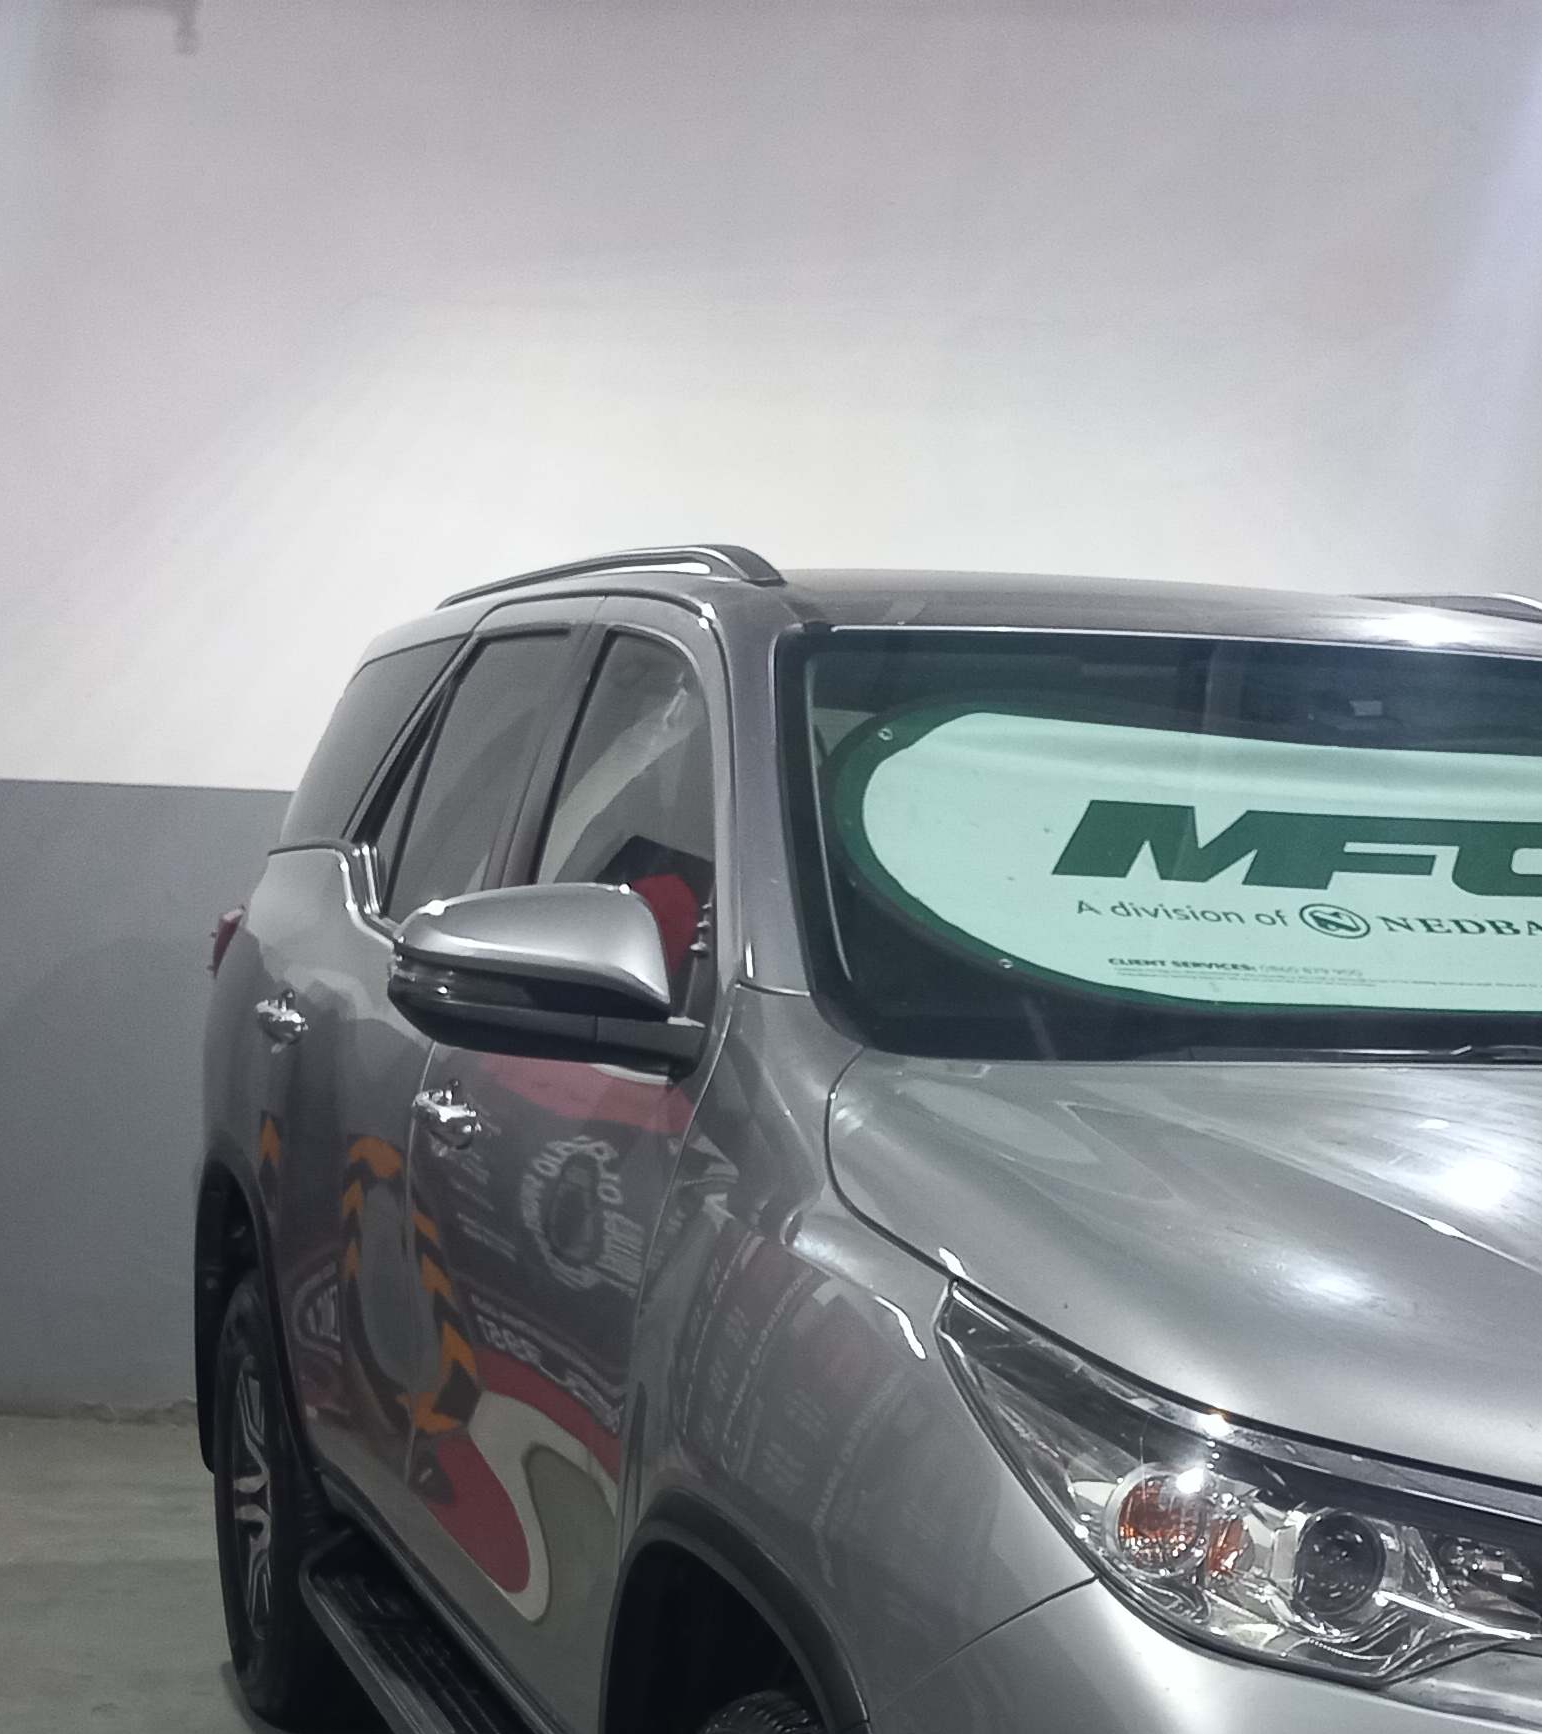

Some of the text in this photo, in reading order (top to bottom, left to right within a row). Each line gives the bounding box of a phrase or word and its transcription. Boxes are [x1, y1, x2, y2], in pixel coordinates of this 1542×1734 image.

[1076, 900, 1100, 914] A
[1111, 901, 1246, 925] division
[1258, 909, 1290, 927] of
